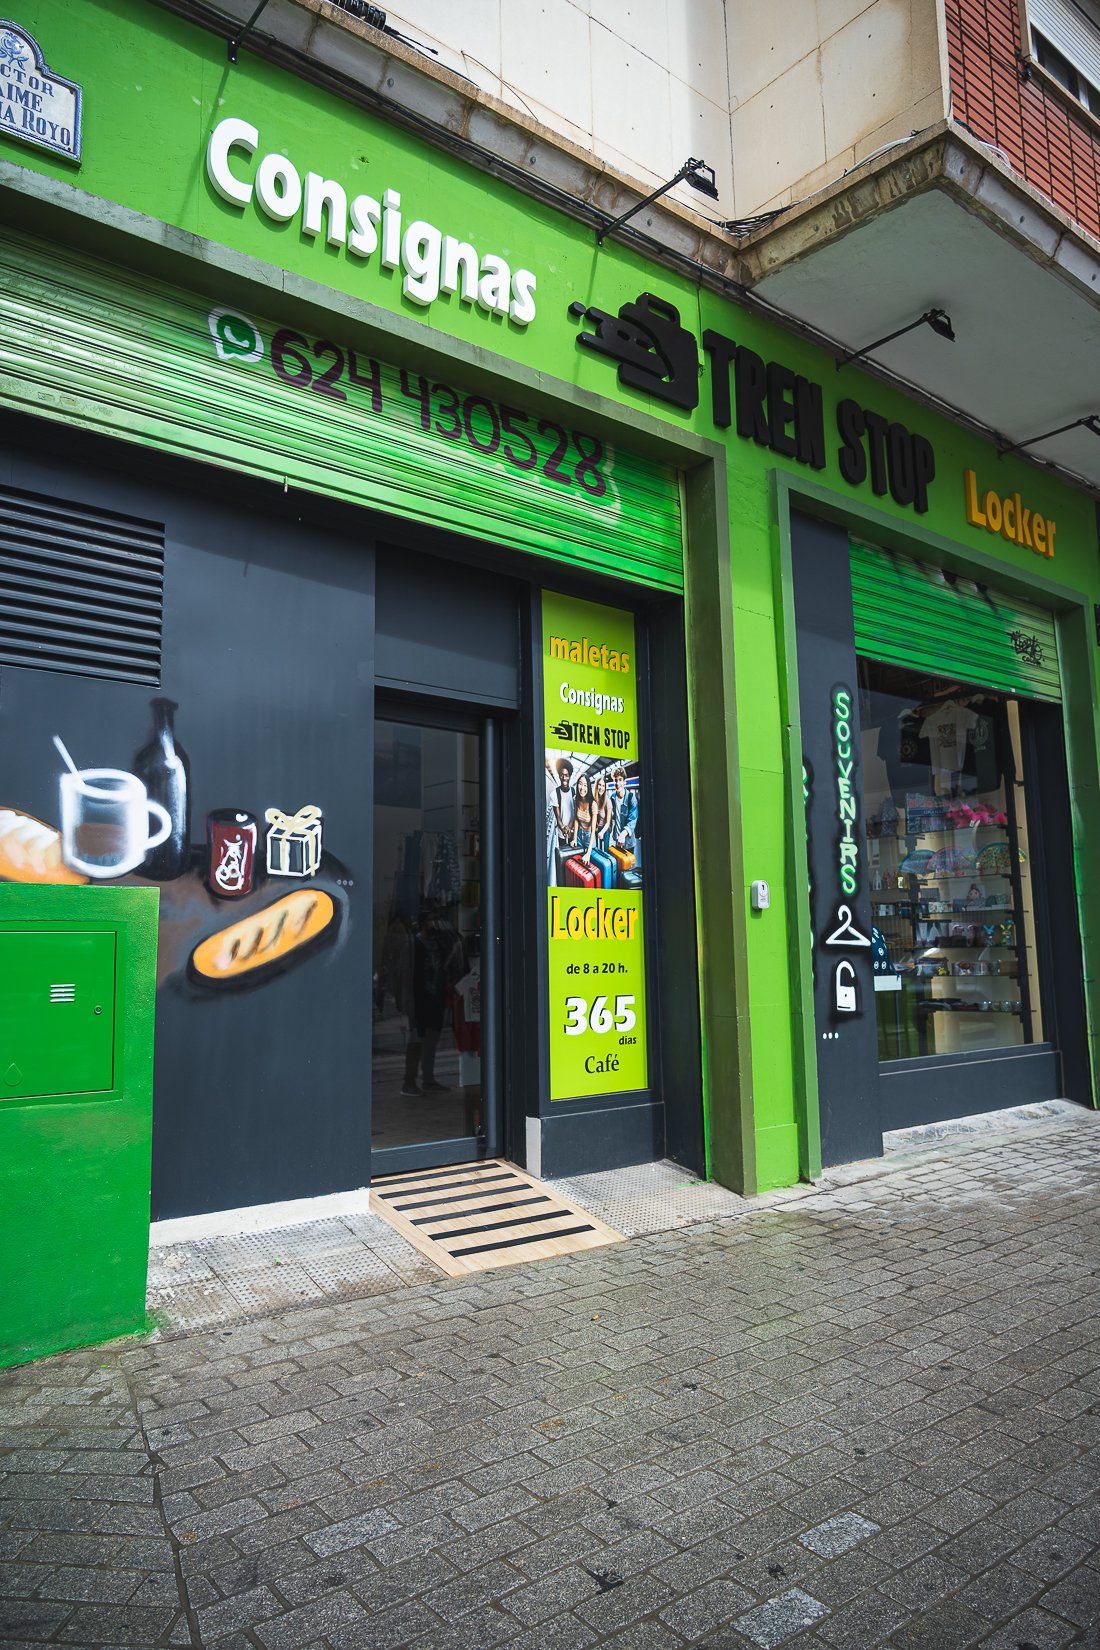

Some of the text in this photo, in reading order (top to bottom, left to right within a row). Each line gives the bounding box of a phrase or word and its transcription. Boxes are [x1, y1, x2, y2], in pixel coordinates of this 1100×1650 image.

[21, 106, 71, 146] ROYO
[207, 117, 537, 327] Consignas
[270, 329, 608, 498] 624 430528
[703, 328, 936, 514] TREN STOP
[964, 469, 1056, 559] Locker
[550, 636, 630, 673] maletas
[559, 682, 625, 715] Consignas
[573, 722, 630, 750] TREN STOP
[835, 691, 859, 894] SOUVENIRS
[551, 896, 638, 940] Locker
[566, 962, 628, 975] de 8 a 20 h.
[563, 994, 637, 1036] 365
[584, 1053, 620, 1074] Café
